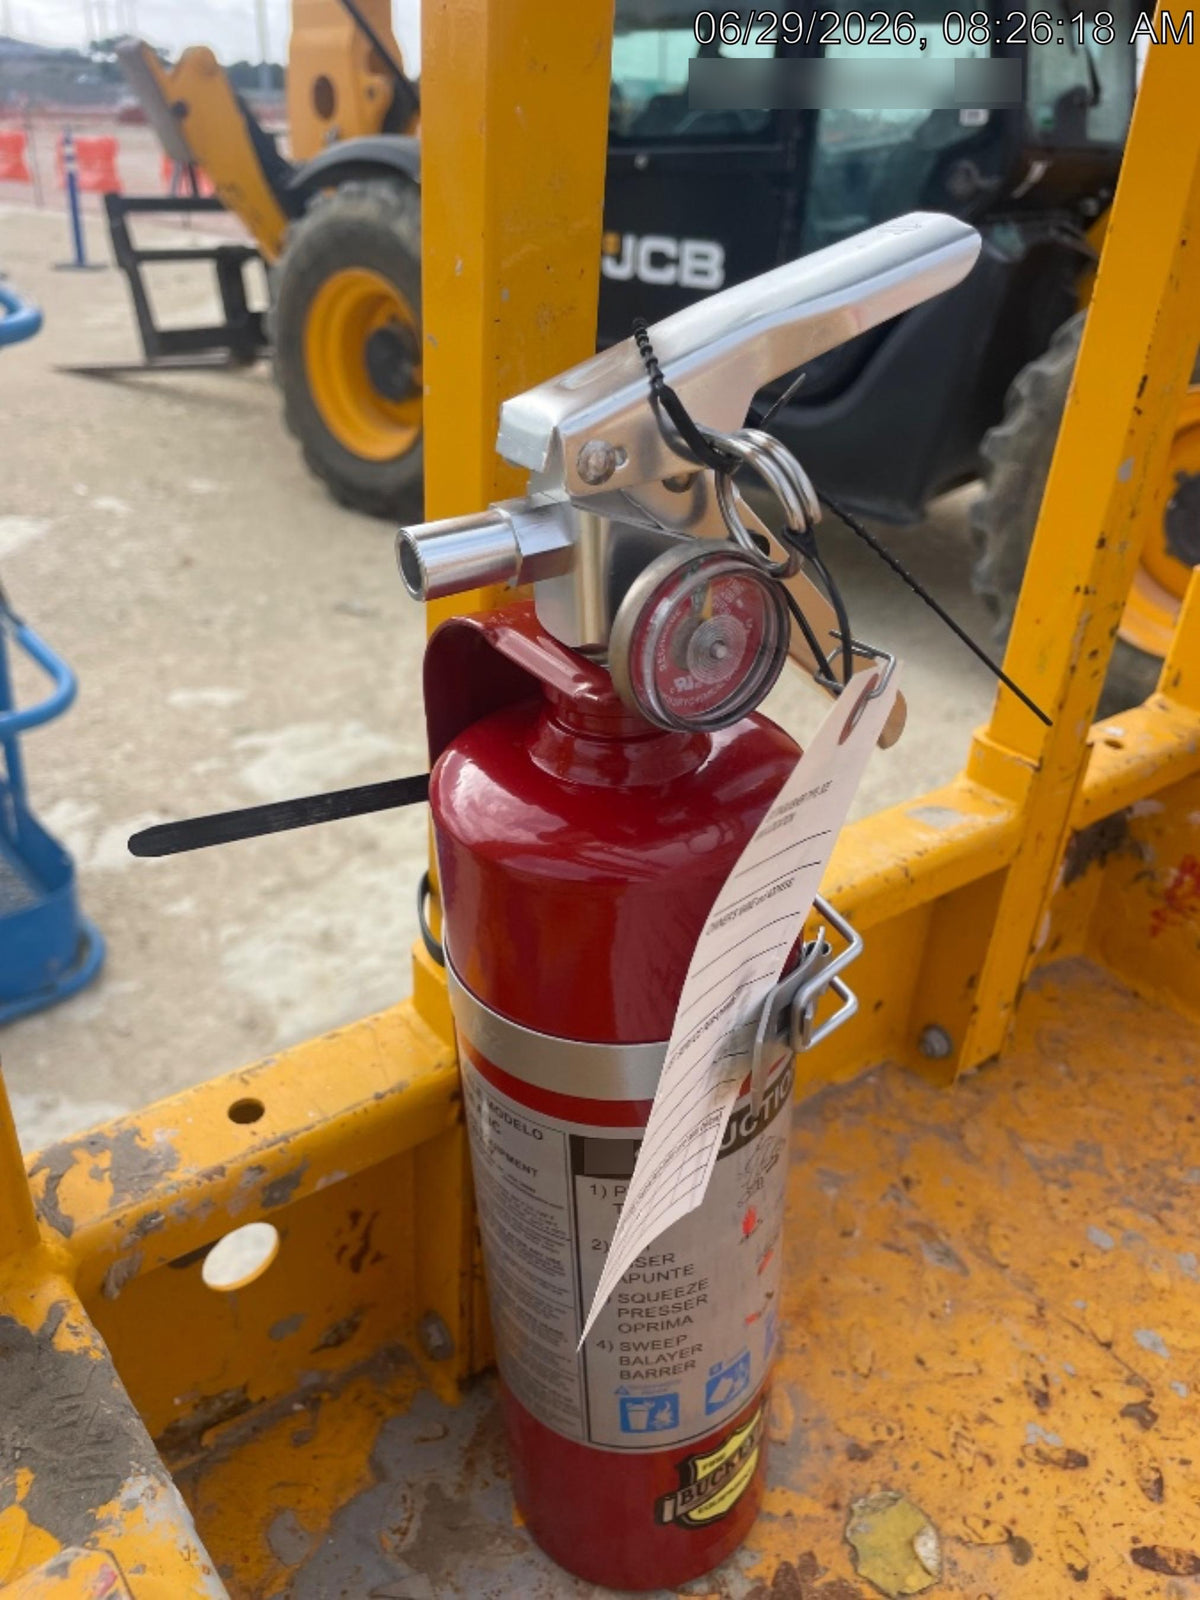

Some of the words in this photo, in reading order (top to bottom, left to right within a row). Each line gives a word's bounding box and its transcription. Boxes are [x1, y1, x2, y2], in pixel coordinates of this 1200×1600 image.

[602, 233, 725, 290] JCB
[590, 1184, 607, 1199] 1)
[618, 1280, 709, 1304] SQUEEZE
[618, 1294, 708, 1318] PRESSER
[618, 1315, 694, 1334] OPRIMA
[596, 1339, 615, 1353] 4)
[620, 1334, 688, 1352] SWEEP
[619, 1343, 703, 1366] BALAYER
[619, 1359, 696, 1380] BARRER
